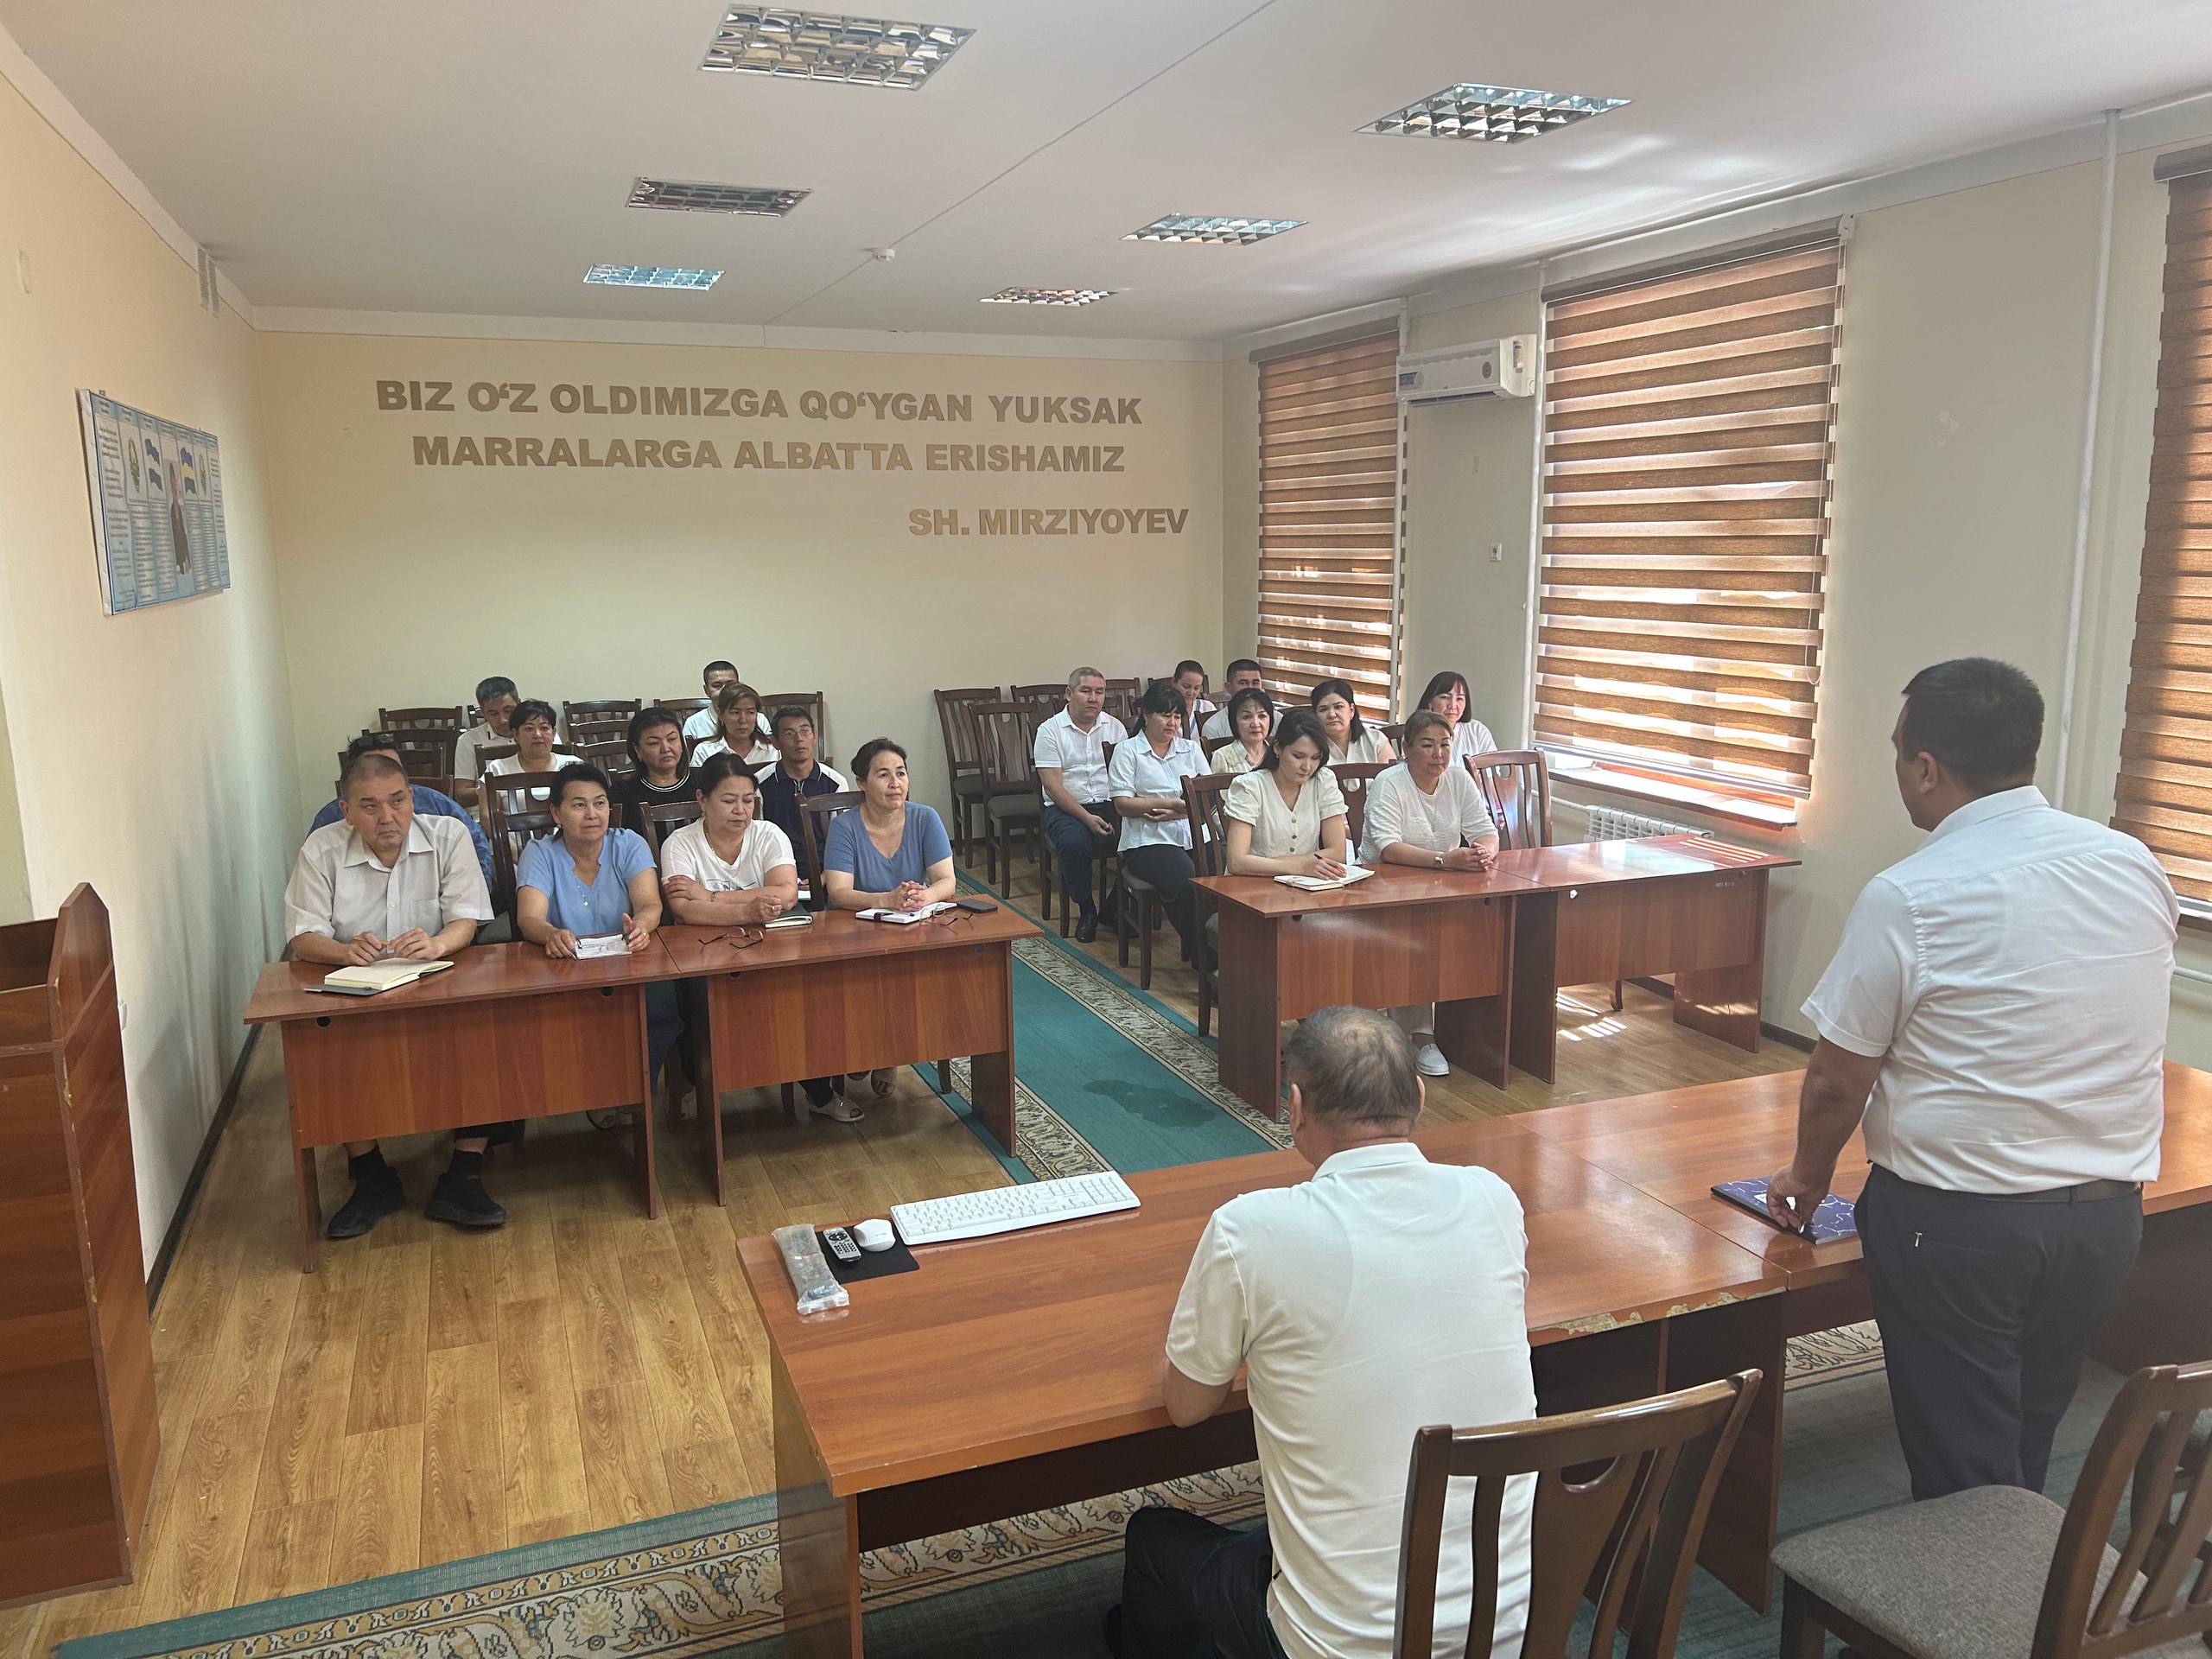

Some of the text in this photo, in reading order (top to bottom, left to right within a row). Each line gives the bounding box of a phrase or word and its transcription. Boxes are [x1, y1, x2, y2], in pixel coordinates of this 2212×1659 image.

[373, 380, 456, 412] BIZ
[550, 384, 790, 418] OLDIMIZGA
[988, 395, 1143, 424] YUKSAK
[412, 435, 1125, 473] MARRALARGA ALBATTA ERISHAMIZ
[908, 507, 1190, 537] SH. MIRZIYOYEV
